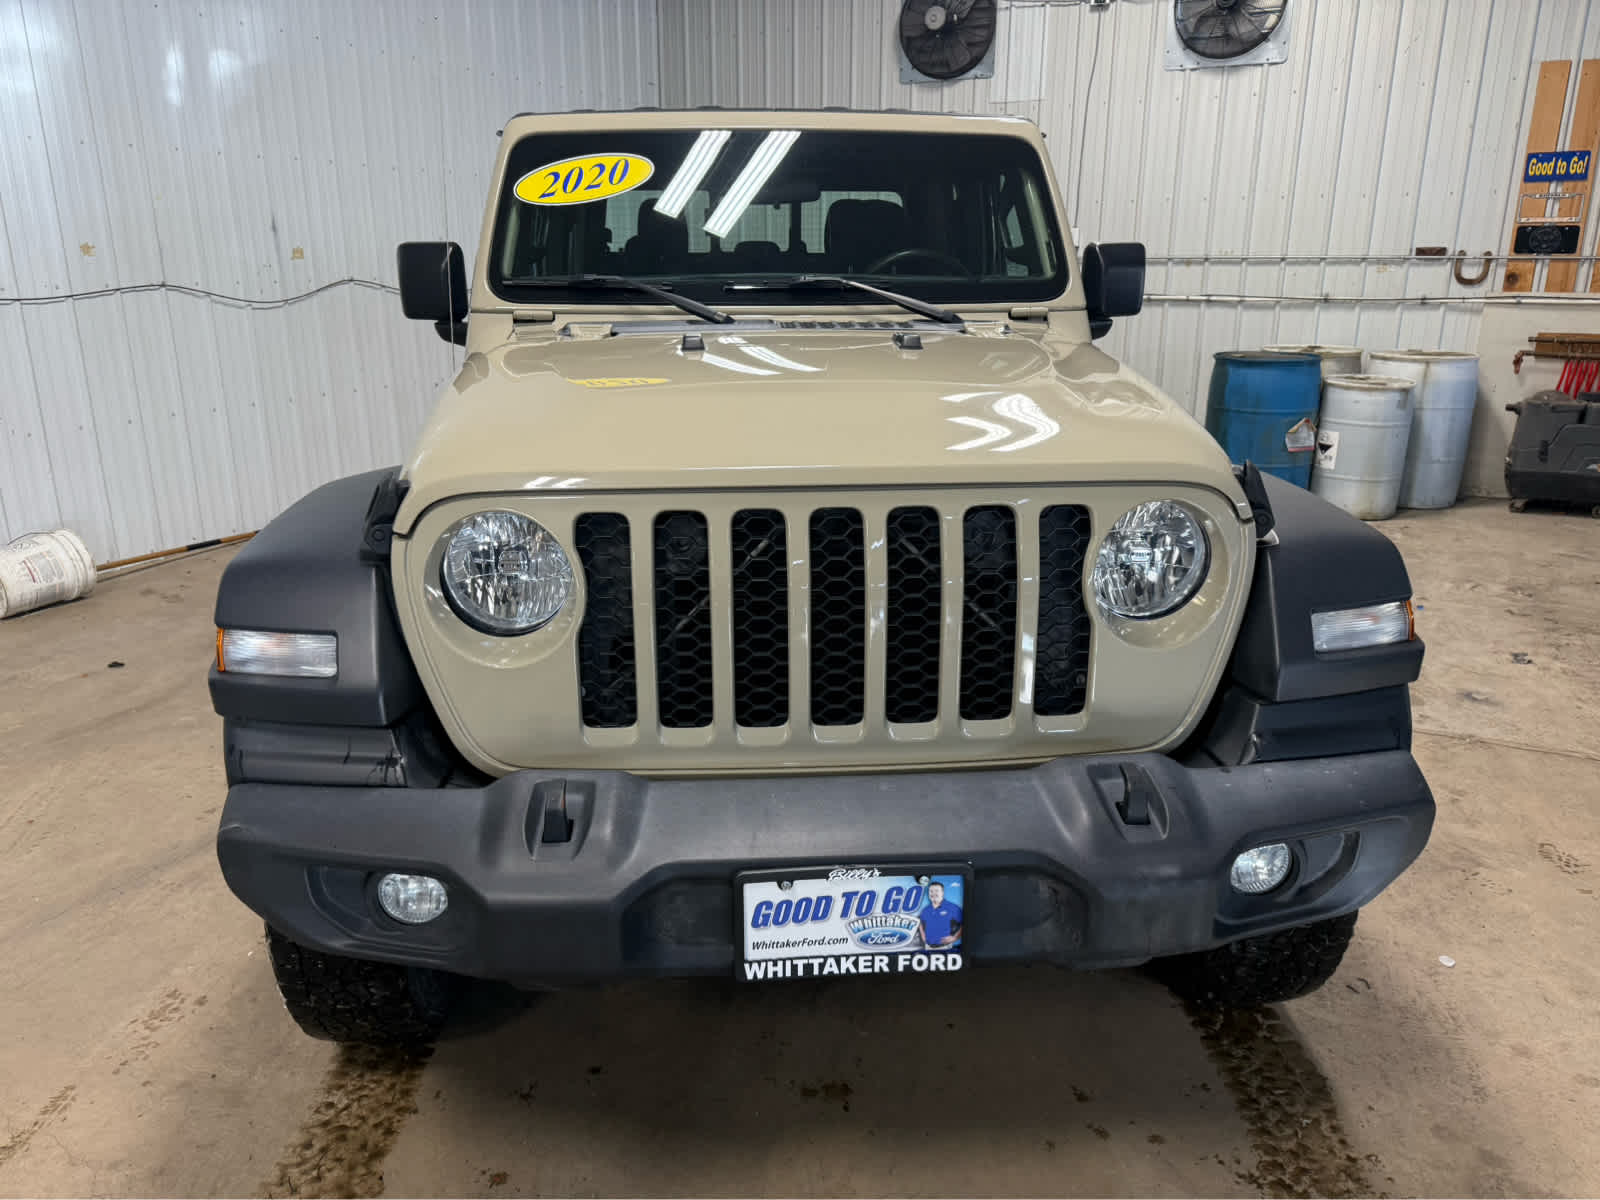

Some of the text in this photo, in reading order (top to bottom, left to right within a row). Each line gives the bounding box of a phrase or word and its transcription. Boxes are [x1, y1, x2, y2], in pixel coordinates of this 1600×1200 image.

[1528, 155, 1589, 176] Good to Go!
[538, 158, 630, 199] 2020
[751, 885, 925, 929] GOOD TO GO
[850, 914, 919, 934] Whittaker
[752, 936, 849, 950] WhittakerFord.com
[867, 932, 900, 946] Ford
[744, 953, 963, 980] WHITTAKER FORD
